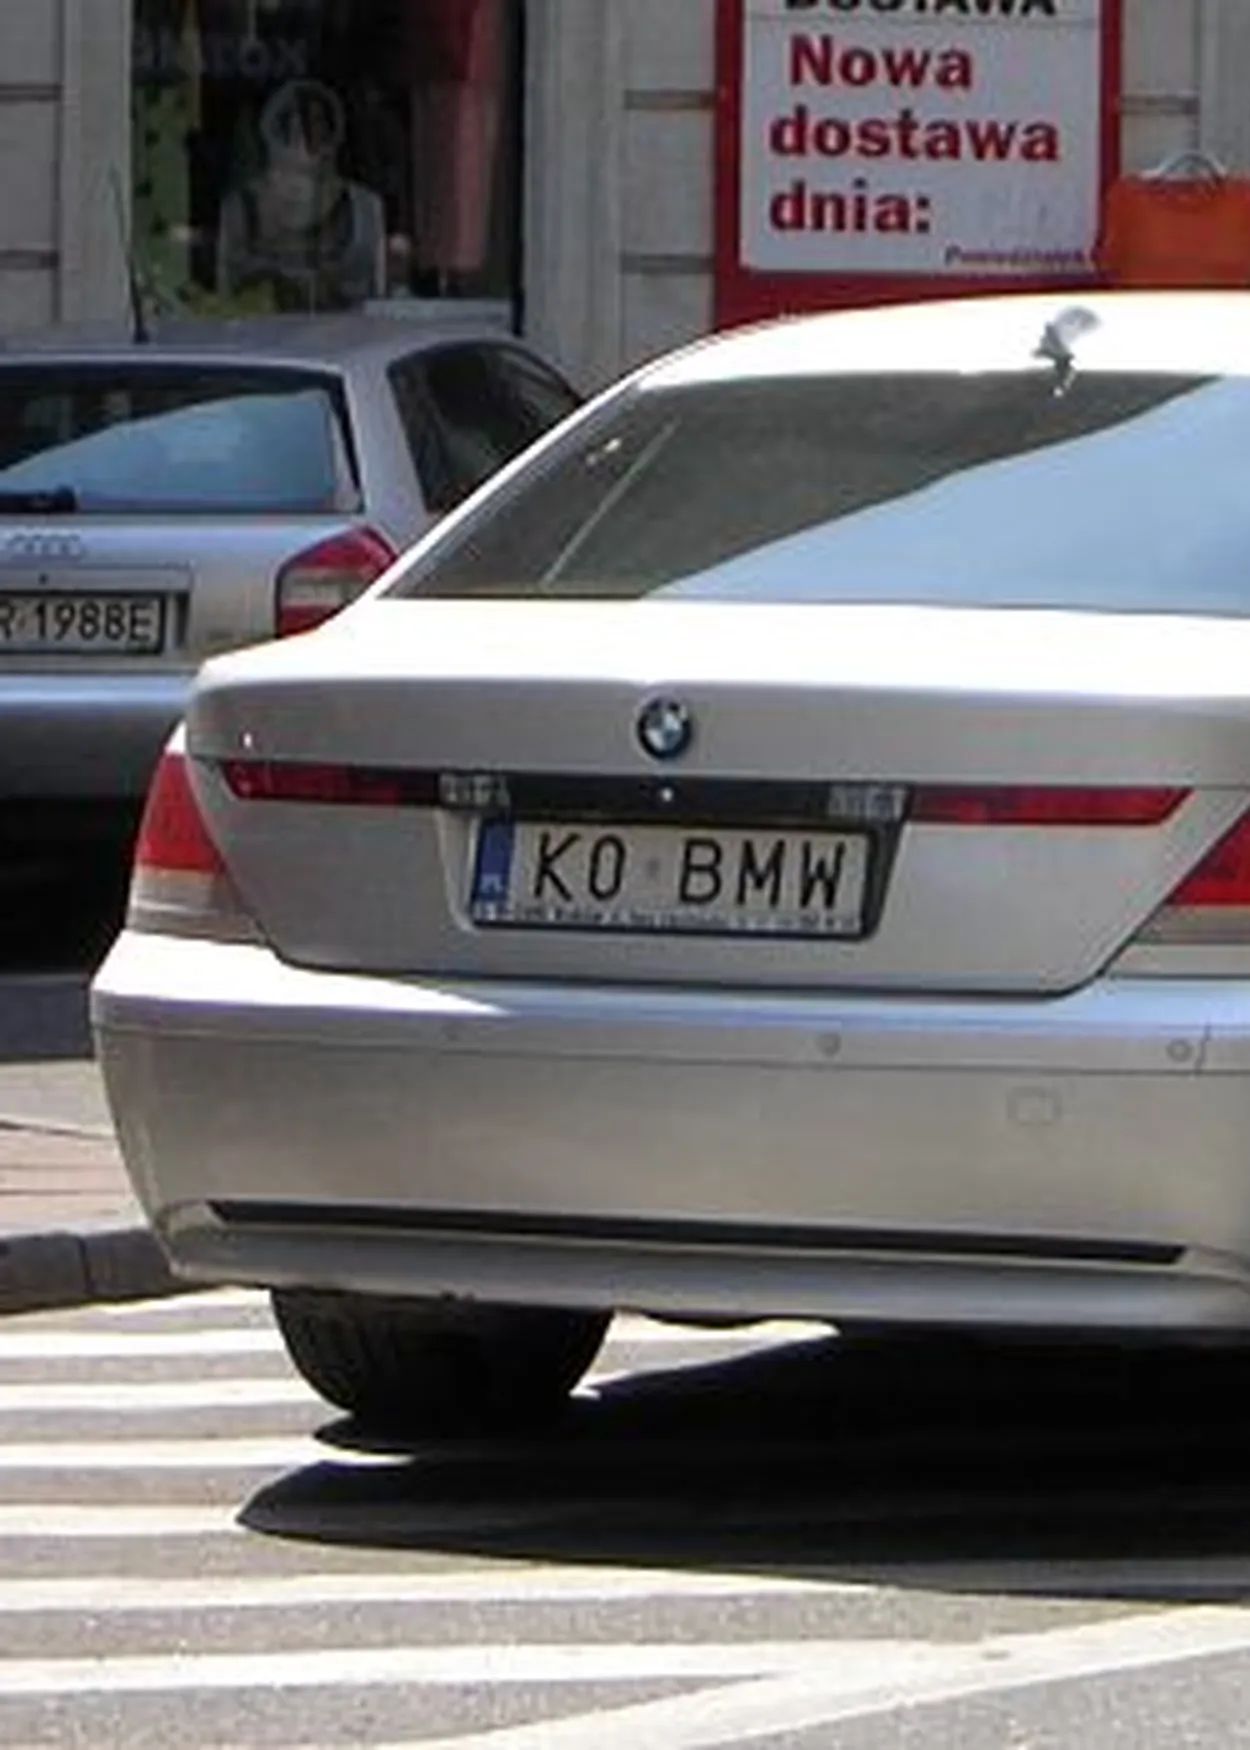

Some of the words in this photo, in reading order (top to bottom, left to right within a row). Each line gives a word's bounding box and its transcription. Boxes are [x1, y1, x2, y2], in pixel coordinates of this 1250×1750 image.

[789, 33, 972, 89] Nowa
[769, 104, 1058, 161] dostawa
[769, 177, 931, 233] dnia:
[679, 837, 847, 910] BMW
